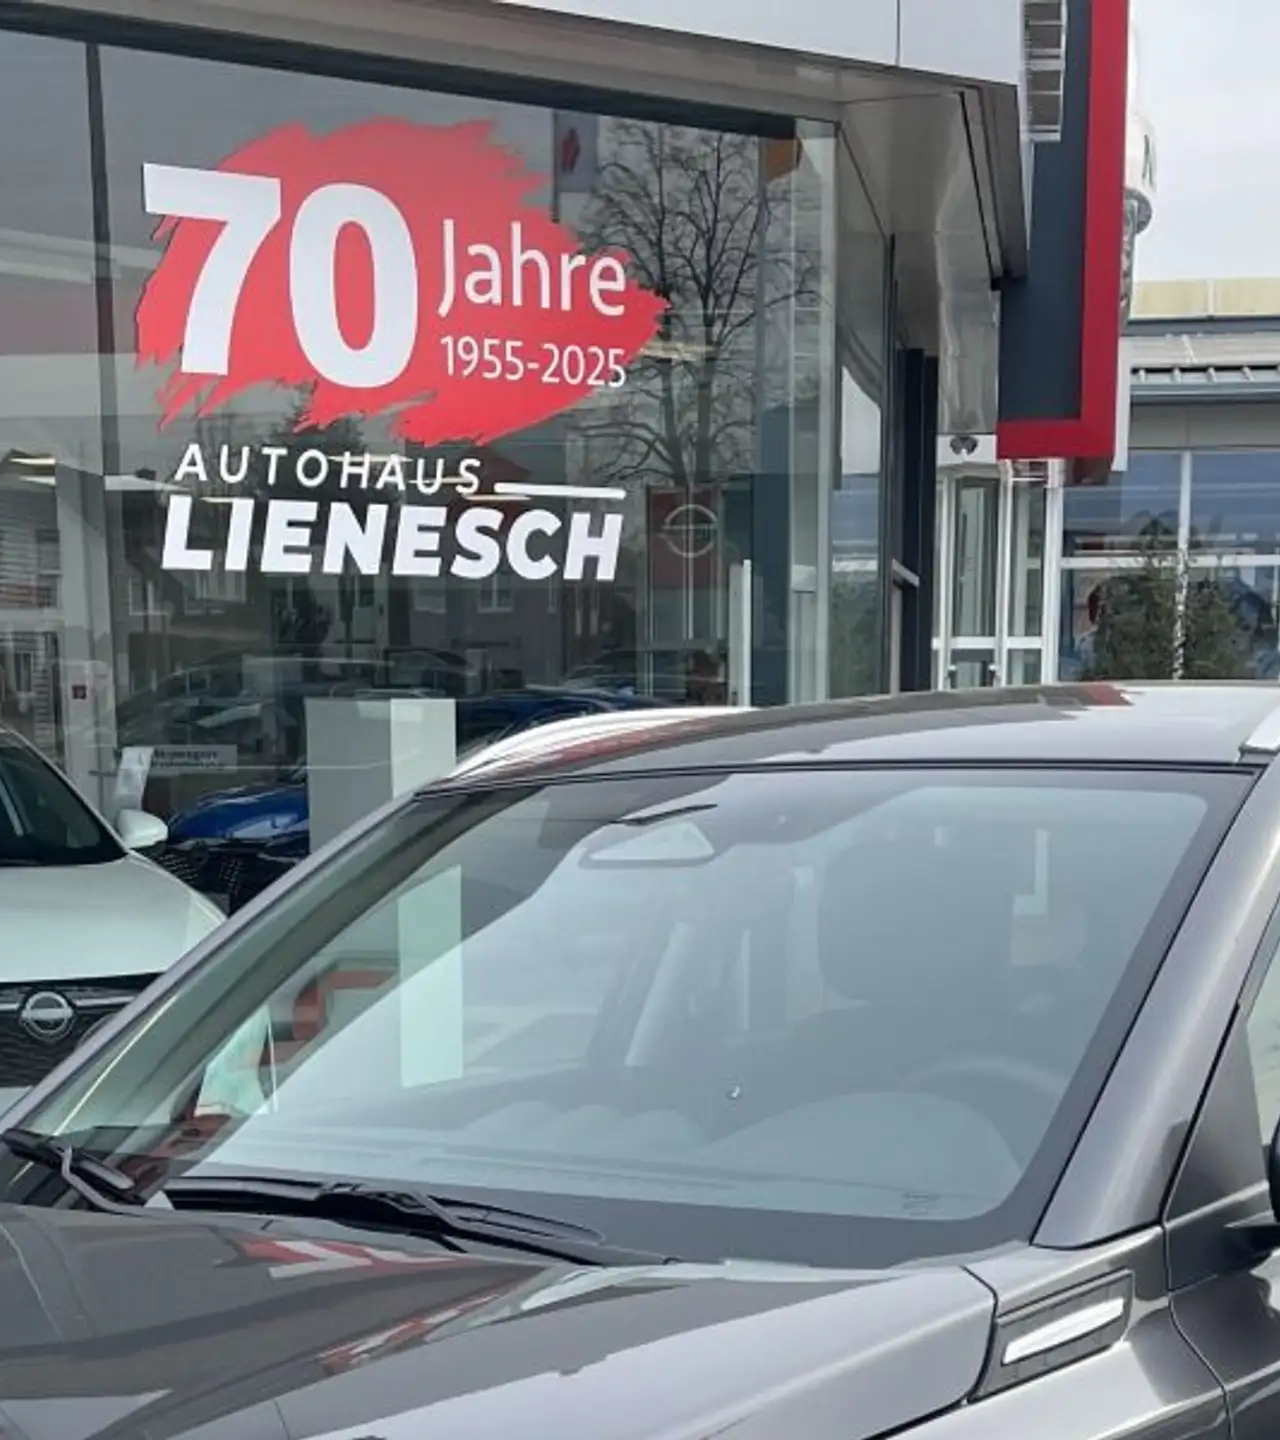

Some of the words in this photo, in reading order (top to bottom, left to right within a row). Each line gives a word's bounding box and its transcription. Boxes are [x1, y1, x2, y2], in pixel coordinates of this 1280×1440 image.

[143, 162, 419, 389] 70
[437, 218, 626, 317] Jahre
[439, 335, 627, 388] 1955-2025
[174, 442, 483, 495] AUTOHAUS
[160, 494, 625, 581] LIENESCH
